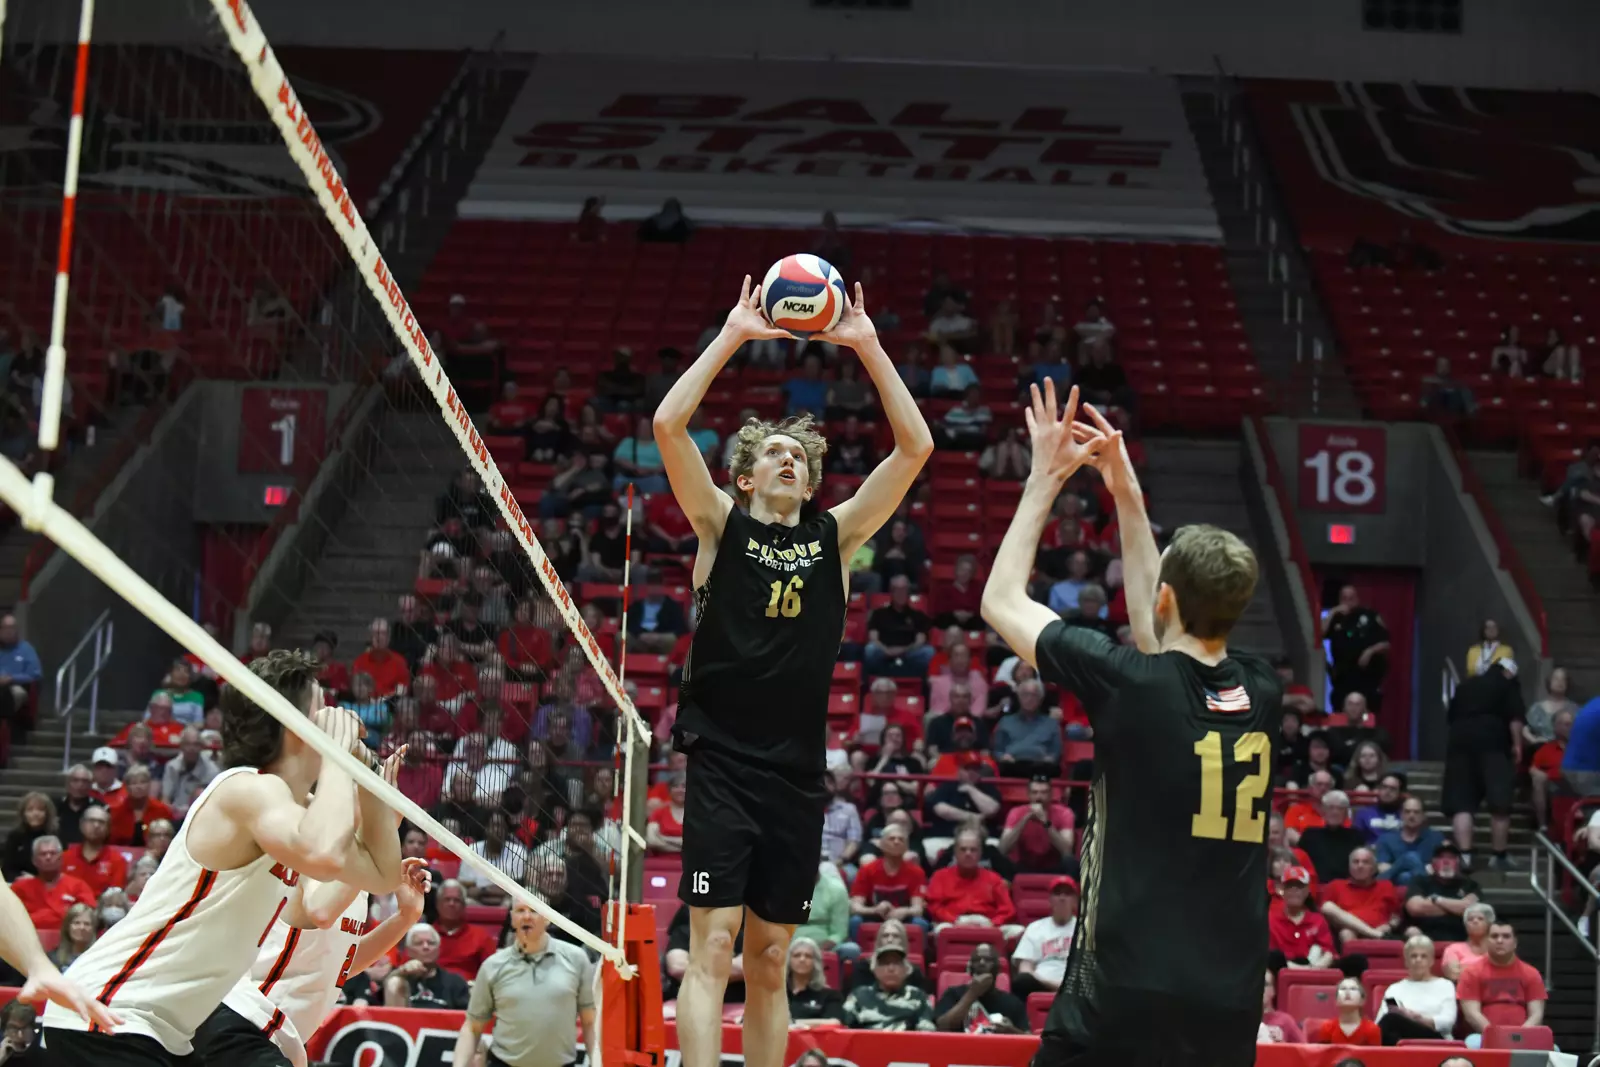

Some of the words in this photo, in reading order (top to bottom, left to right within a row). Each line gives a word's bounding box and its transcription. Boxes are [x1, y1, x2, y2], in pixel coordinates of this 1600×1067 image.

[597, 93, 1123, 135] BALL
[512, 121, 1173, 168] STATE
[517, 151, 1150, 188] BASKETBALL
[782, 300, 815, 314] NCAA
[270, 414, 295, 466] 1
[1303, 449, 1376, 505] 18
[765, 574, 804, 618] 16
[1191, 730, 1271, 843] 12
[692, 870, 710, 895] 16
